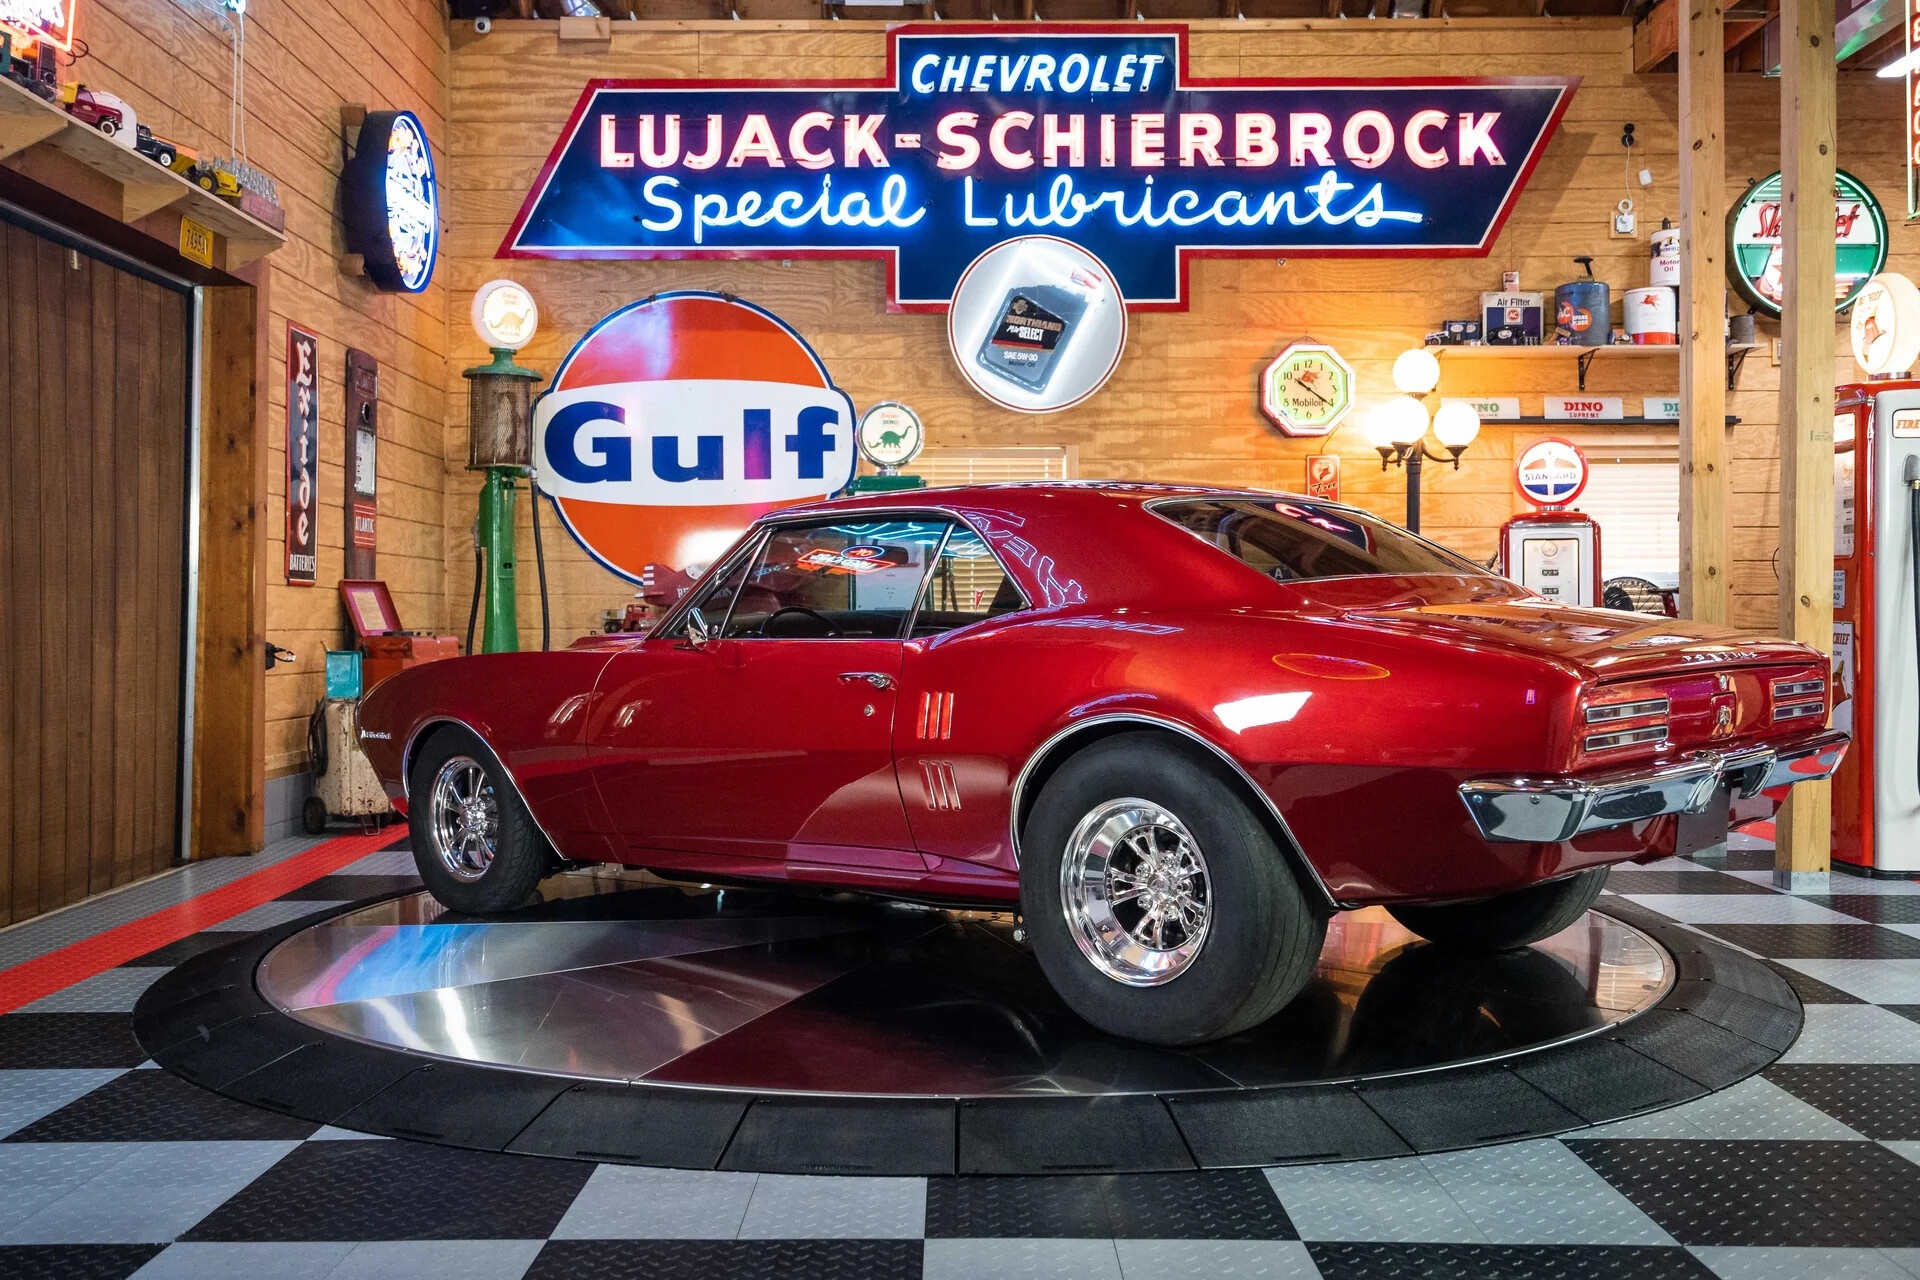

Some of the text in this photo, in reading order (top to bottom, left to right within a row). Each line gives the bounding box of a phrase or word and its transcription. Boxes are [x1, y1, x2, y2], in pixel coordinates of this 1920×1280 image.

[911, 53, 1165, 94] CHEVROLET
[601, 110, 1507, 170] LUJACK-SCHIERBROCK
[641, 170, 1423, 243] Special Lubricants
[1497, 298, 1531, 307] Air Filter
[1557, 307, 1570, 318] AC
[1006, 315, 1063, 331] NORTHLAND
[1019, 326, 1044, 341] SELECT
[1004, 351, 1017, 360] SAE
[1293, 363, 1300, 371] 11
[1304, 360, 1313, 369] 12
[1320, 363, 1324, 371] 1
[1283, 372, 1293, 381] 10
[1328, 372, 1334, 381] 2
[1280, 385, 1286, 393] 9
[1332, 385, 1337, 394] 3
[1284, 398, 1290, 407] 8
[1329, 399, 1334, 407] 4
[1564, 402, 1603, 412] DINO
[1663, 402, 1679, 412] DI
[1306, 411, 1312, 419] 6
[1321, 408, 1326, 416] 5
[544, 400, 839, 484] Gulf
[1525, 471, 1576, 481] STANDARD
[1311, 482, 1337, 494] Free
[355, 516, 375, 534] ATLANTIC
[289, 553, 315, 572] BATTERIES
